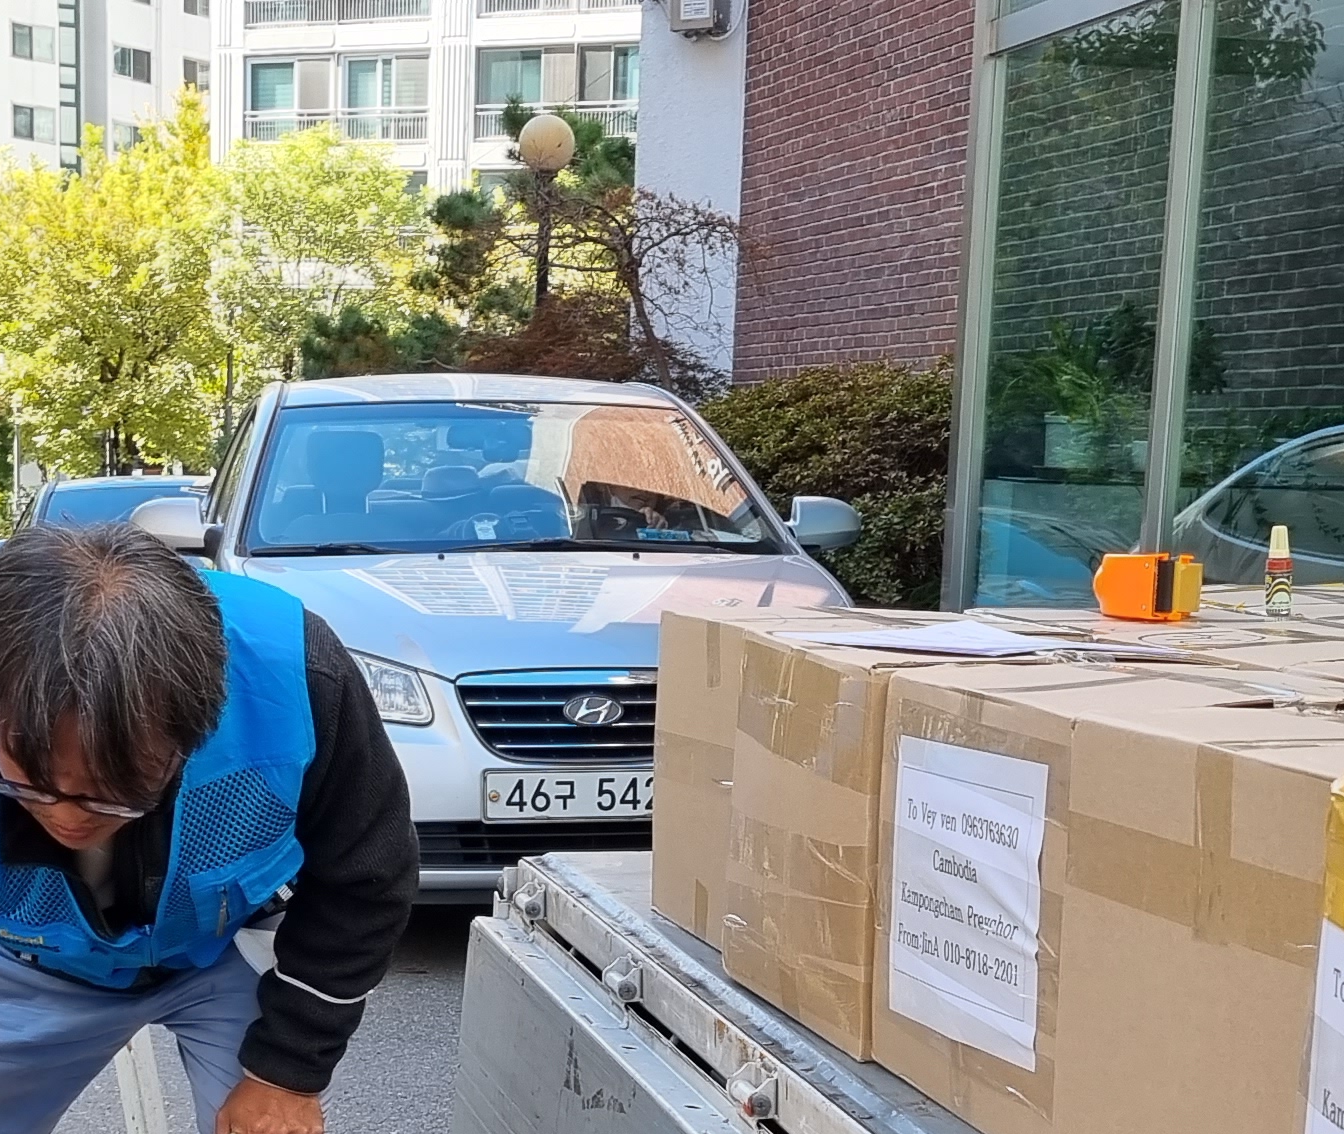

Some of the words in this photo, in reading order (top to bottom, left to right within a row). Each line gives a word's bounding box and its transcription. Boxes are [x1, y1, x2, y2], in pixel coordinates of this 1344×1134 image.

[506, 778, 576, 812] 46구
[907, 798, 918, 821] To
[921, 803, 937, 831] Vey
[941, 814, 957, 833] ven
[961, 812, 1020, 850] 0963763630
[932, 849, 978, 885] Cambodia
[900, 881, 964, 924] Kampongcham
[967, 905, 1020, 942] Preychor
[943, 941, 1020, 988] 010-8718-2201
